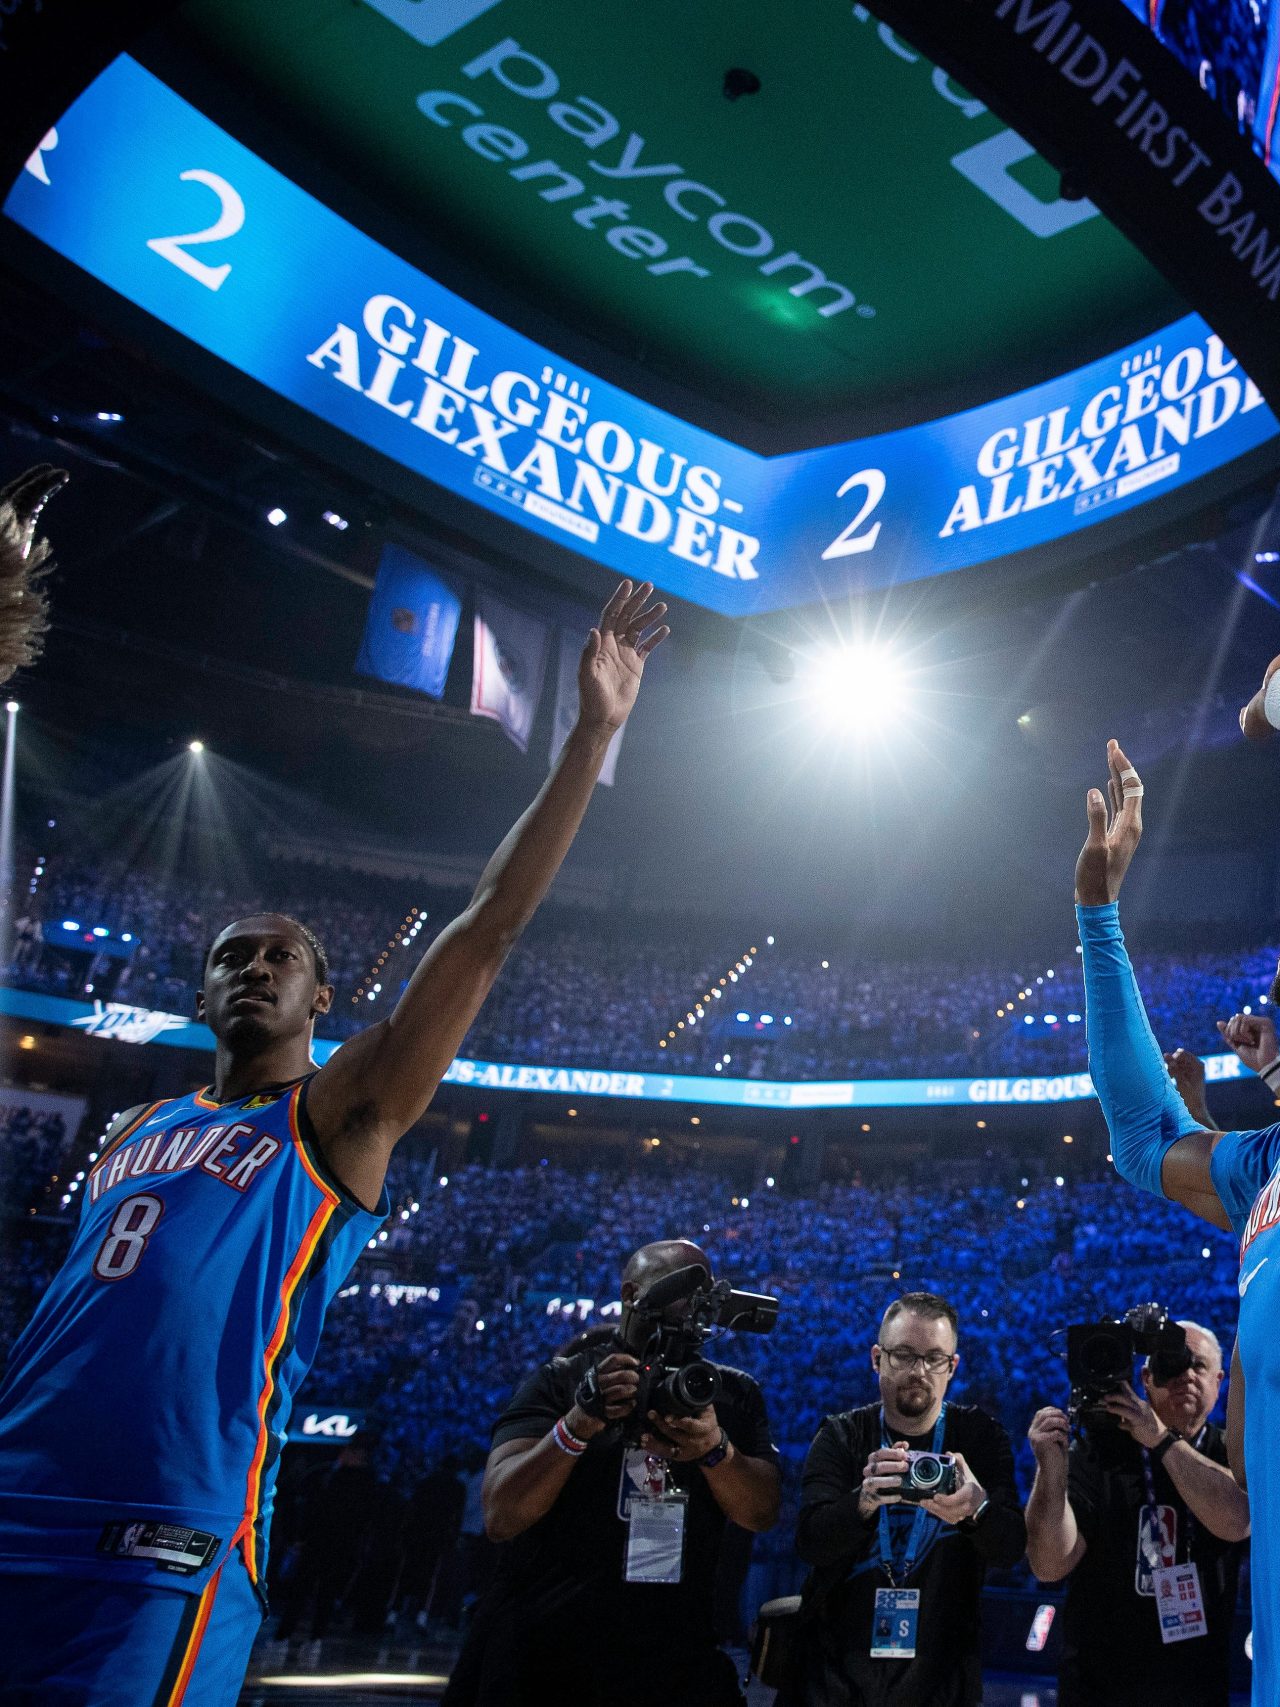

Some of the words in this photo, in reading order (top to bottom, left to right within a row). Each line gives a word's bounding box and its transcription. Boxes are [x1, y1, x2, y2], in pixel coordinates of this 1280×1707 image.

[995, 0, 1212, 188] MIDFIRST
[146, 168, 246, 292] 2
[416, 89, 711, 279] center
[305, 322, 761, 581] ALEXANDER
[362, 293, 745, 517] GILGEOUS-
[821, 467, 887, 561] 2
[89, 1121, 283, 1205] THUNDER
[92, 1191, 166, 1282] 8
[898, 1619, 910, 1637] S
